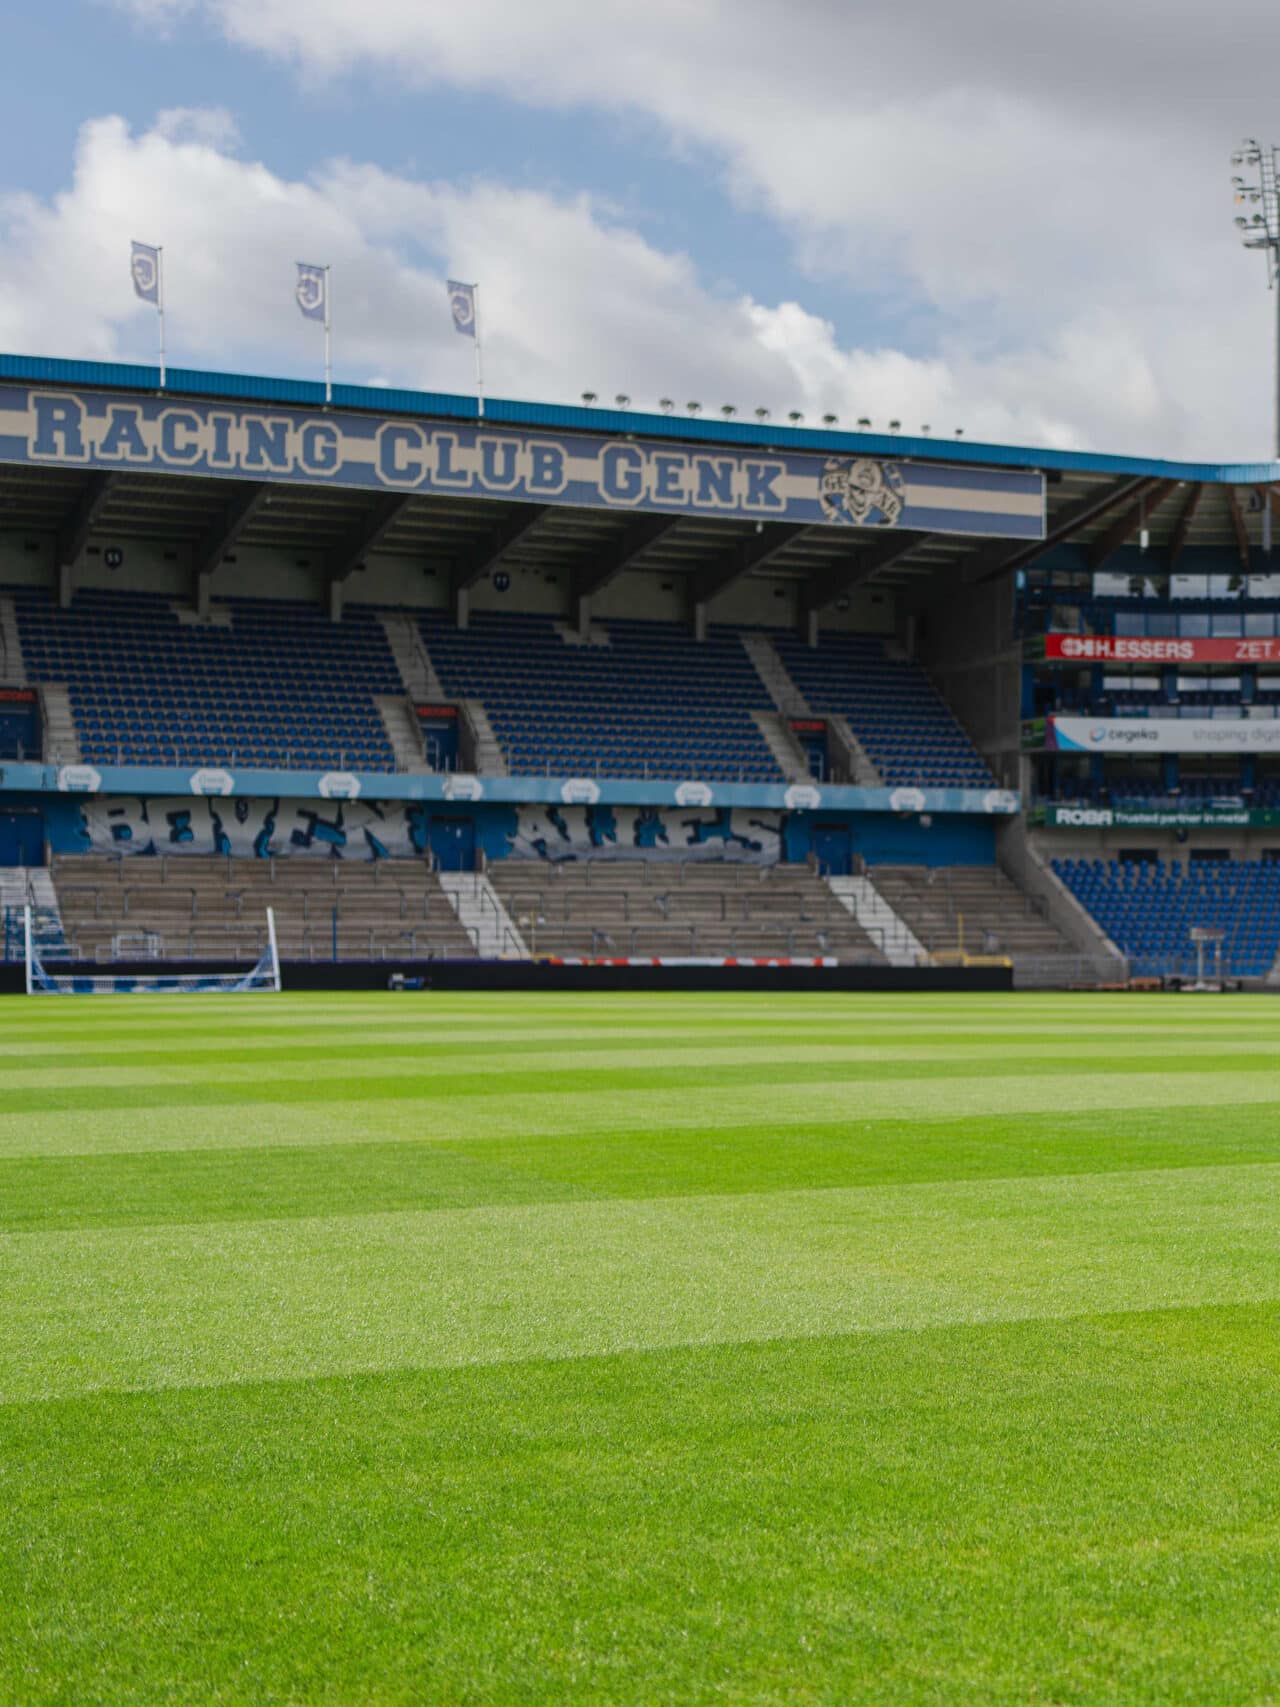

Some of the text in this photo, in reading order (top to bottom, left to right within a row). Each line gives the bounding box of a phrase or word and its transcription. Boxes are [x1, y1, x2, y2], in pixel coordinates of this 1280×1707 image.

[28, 391, 787, 512] RACING CLUB GENK
[1236, 641, 1274, 659] ZET
[1108, 728, 1158, 742] cegeka
[1192, 727, 1247, 743] shaping
[1056, 809, 1113, 825] ROBA
